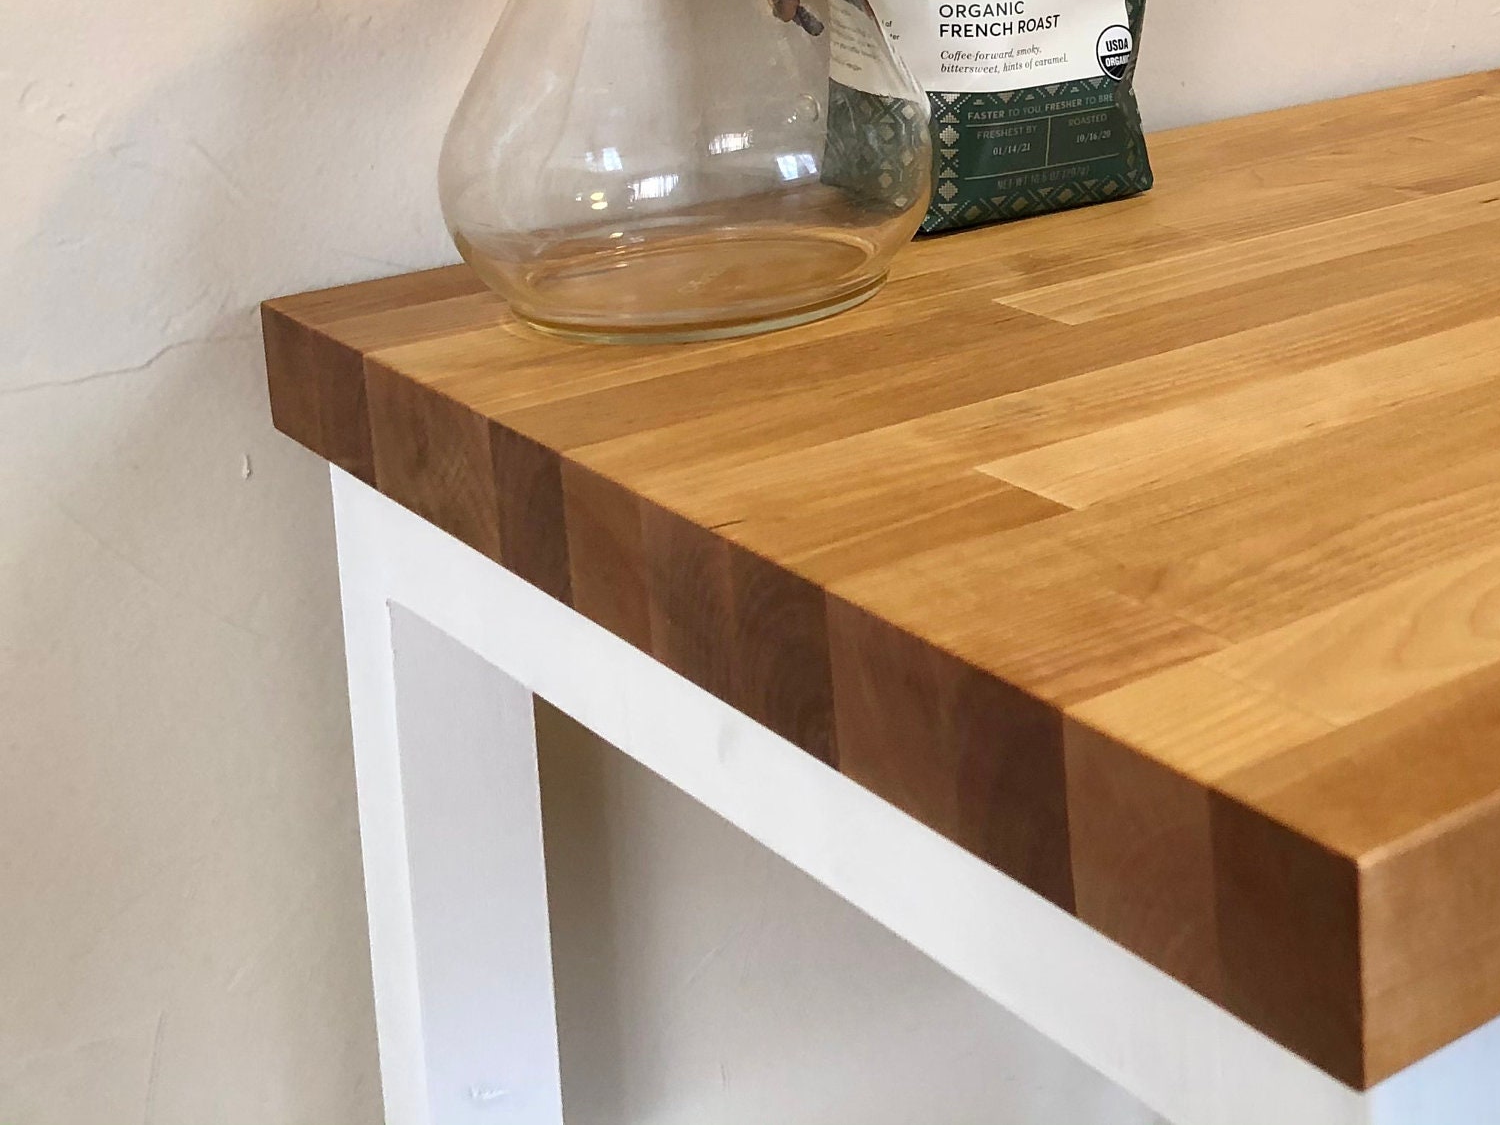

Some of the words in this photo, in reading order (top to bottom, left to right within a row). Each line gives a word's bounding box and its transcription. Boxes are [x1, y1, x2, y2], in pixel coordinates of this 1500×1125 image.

[939, 1, 1025, 18] ORGANIC
[939, 21, 1013, 38] FRENCH
[1018, 14, 1061, 35] ROAST
[1105, 37, 1129, 52] USDA
[1003, 62, 1023, 72] hints
[1025, 58, 1033, 70] of
[967, 110, 1005, 121] FASTER
[1008, 109, 1021, 117] TO
[1045, 99, 1082, 112] FRESHER
[1085, 96, 1097, 105] TO
[1068, 113, 1108, 126] ROASTED
[976, 127, 1023, 140] FRESHEST
[1026, 125, 1038, 134] BY
[992, 143, 1031, 156] 01/14/21
